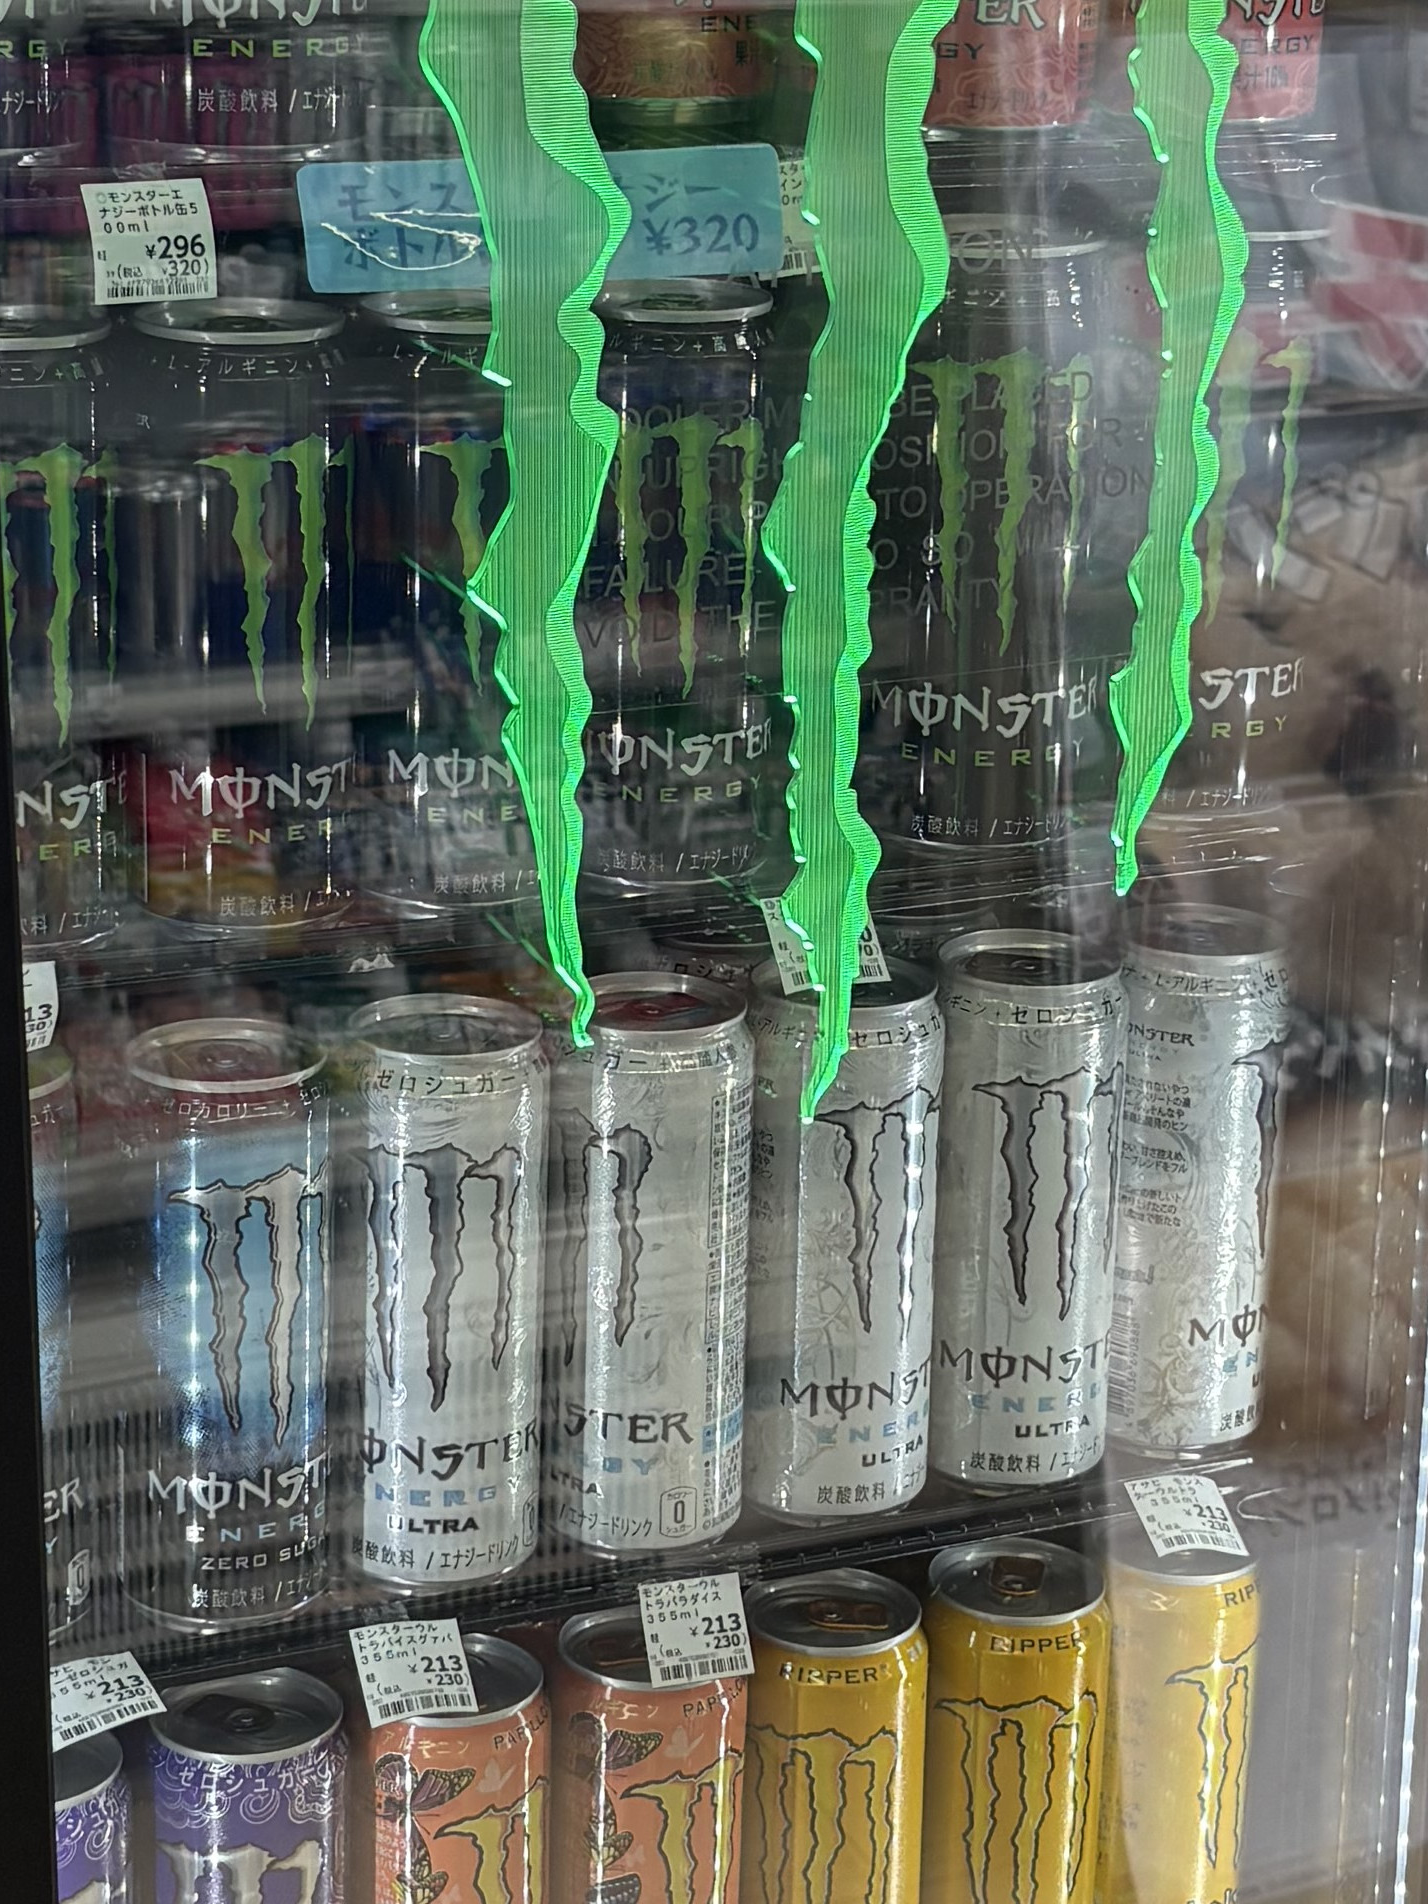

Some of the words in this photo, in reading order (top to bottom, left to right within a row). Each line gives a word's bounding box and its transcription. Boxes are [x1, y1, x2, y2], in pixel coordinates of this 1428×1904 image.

[145, 234, 206, 259] ¥296
[642, 211, 760, 257] ¥320
[1015, 1415, 1091, 1439] ULTRA
[673, 1499, 685, 1525] 0
[202, 1552, 269, 1571] ZERO
[689, 1612, 743, 1638] ¥213
[408, 1654, 464, 1674] ¥213
